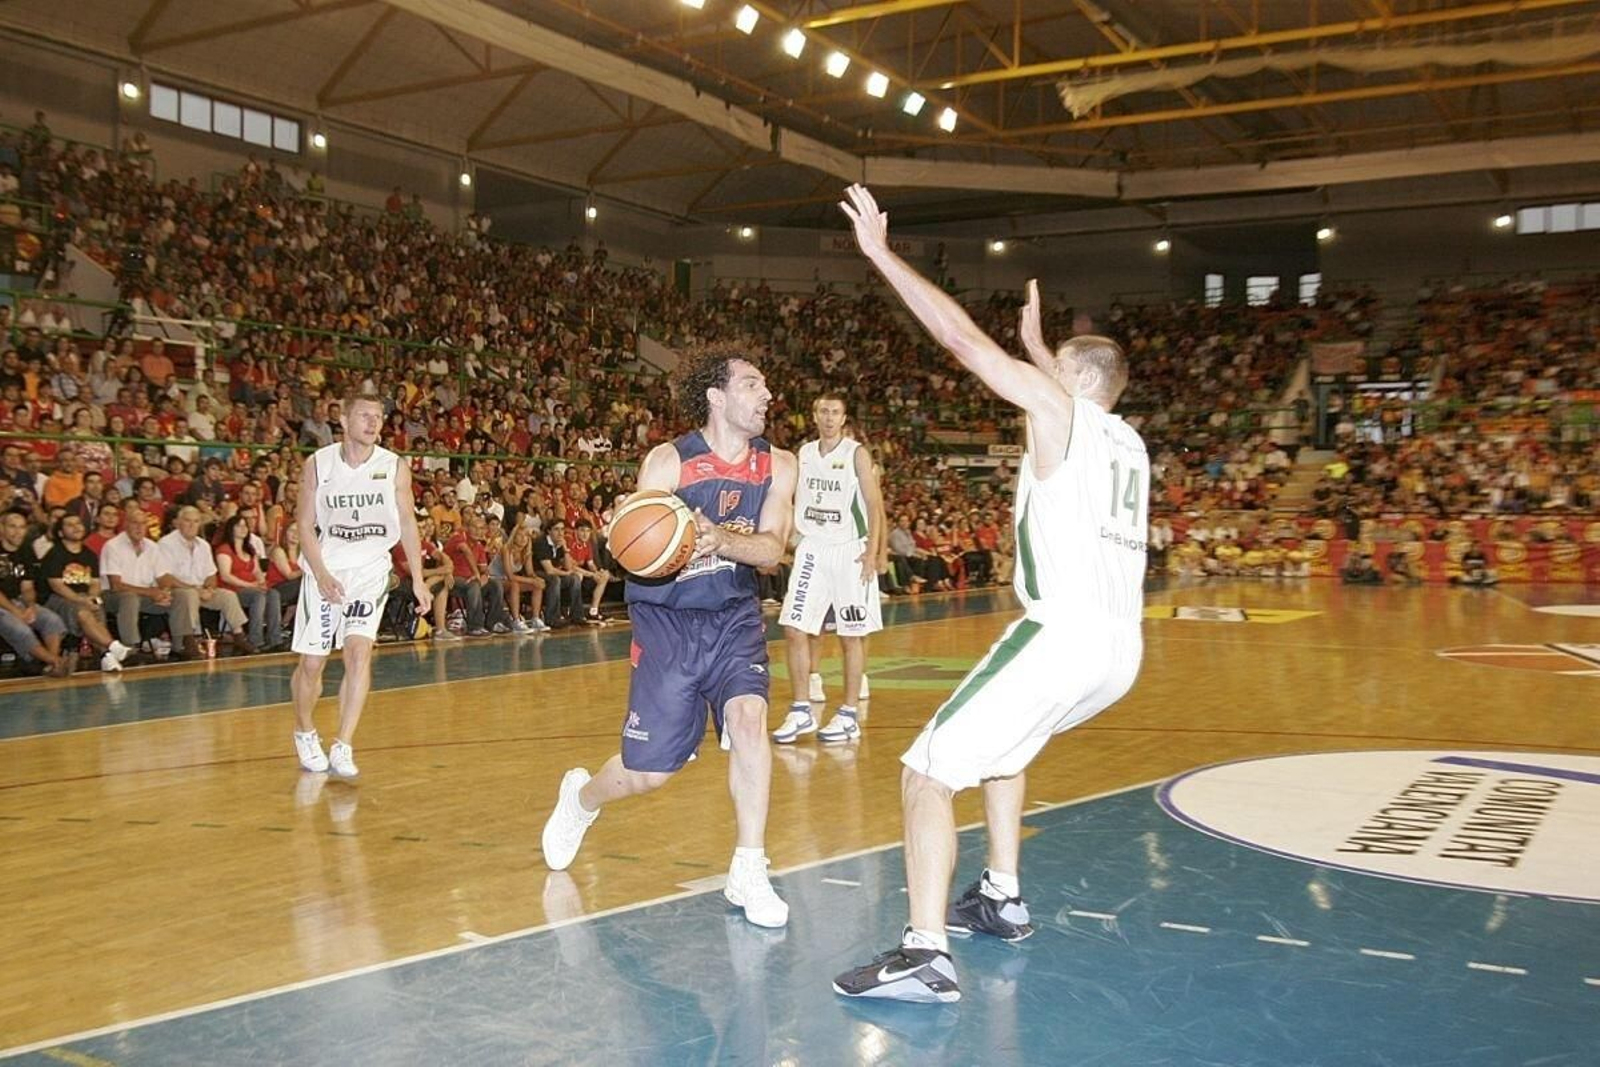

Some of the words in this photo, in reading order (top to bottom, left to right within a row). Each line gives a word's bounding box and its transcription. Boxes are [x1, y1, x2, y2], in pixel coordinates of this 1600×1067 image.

[325, 492, 385, 509] LIETUVA
[351, 509, 360, 522] 4
[815, 491, 823, 504] 5
[1110, 460, 1140, 527] 14
[790, 552, 815, 622] SAMSUNG
[320, 597, 332, 650] SAMS
[1335, 770, 1488, 855] VALENCIANA
[1437, 778, 1565, 868] COMUNITAT
